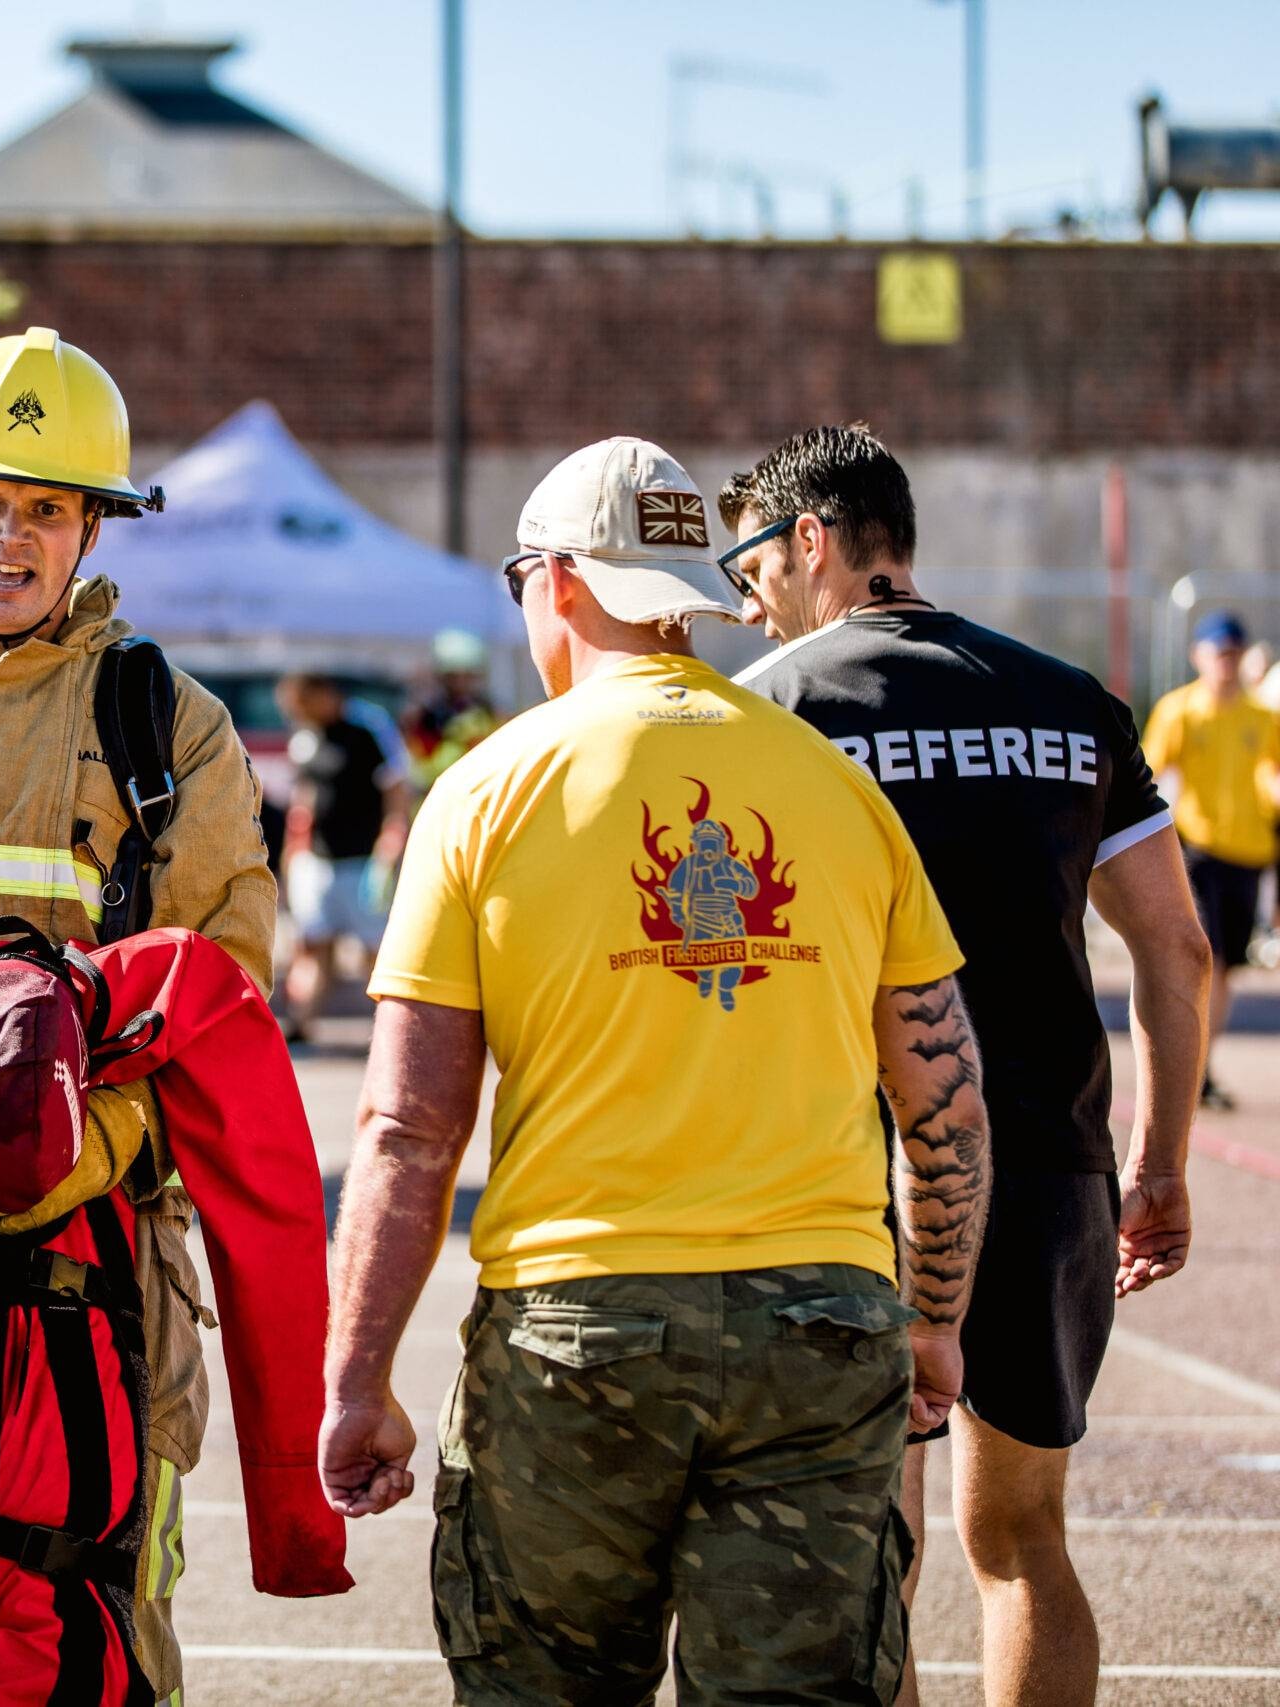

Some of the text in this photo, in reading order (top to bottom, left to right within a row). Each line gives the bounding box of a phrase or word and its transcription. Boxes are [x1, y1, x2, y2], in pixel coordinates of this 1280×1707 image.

[828, 727, 1097, 785] REFEREE
[609, 943, 821, 971] BRITISH FIREFIGHTER CHALLENGE
